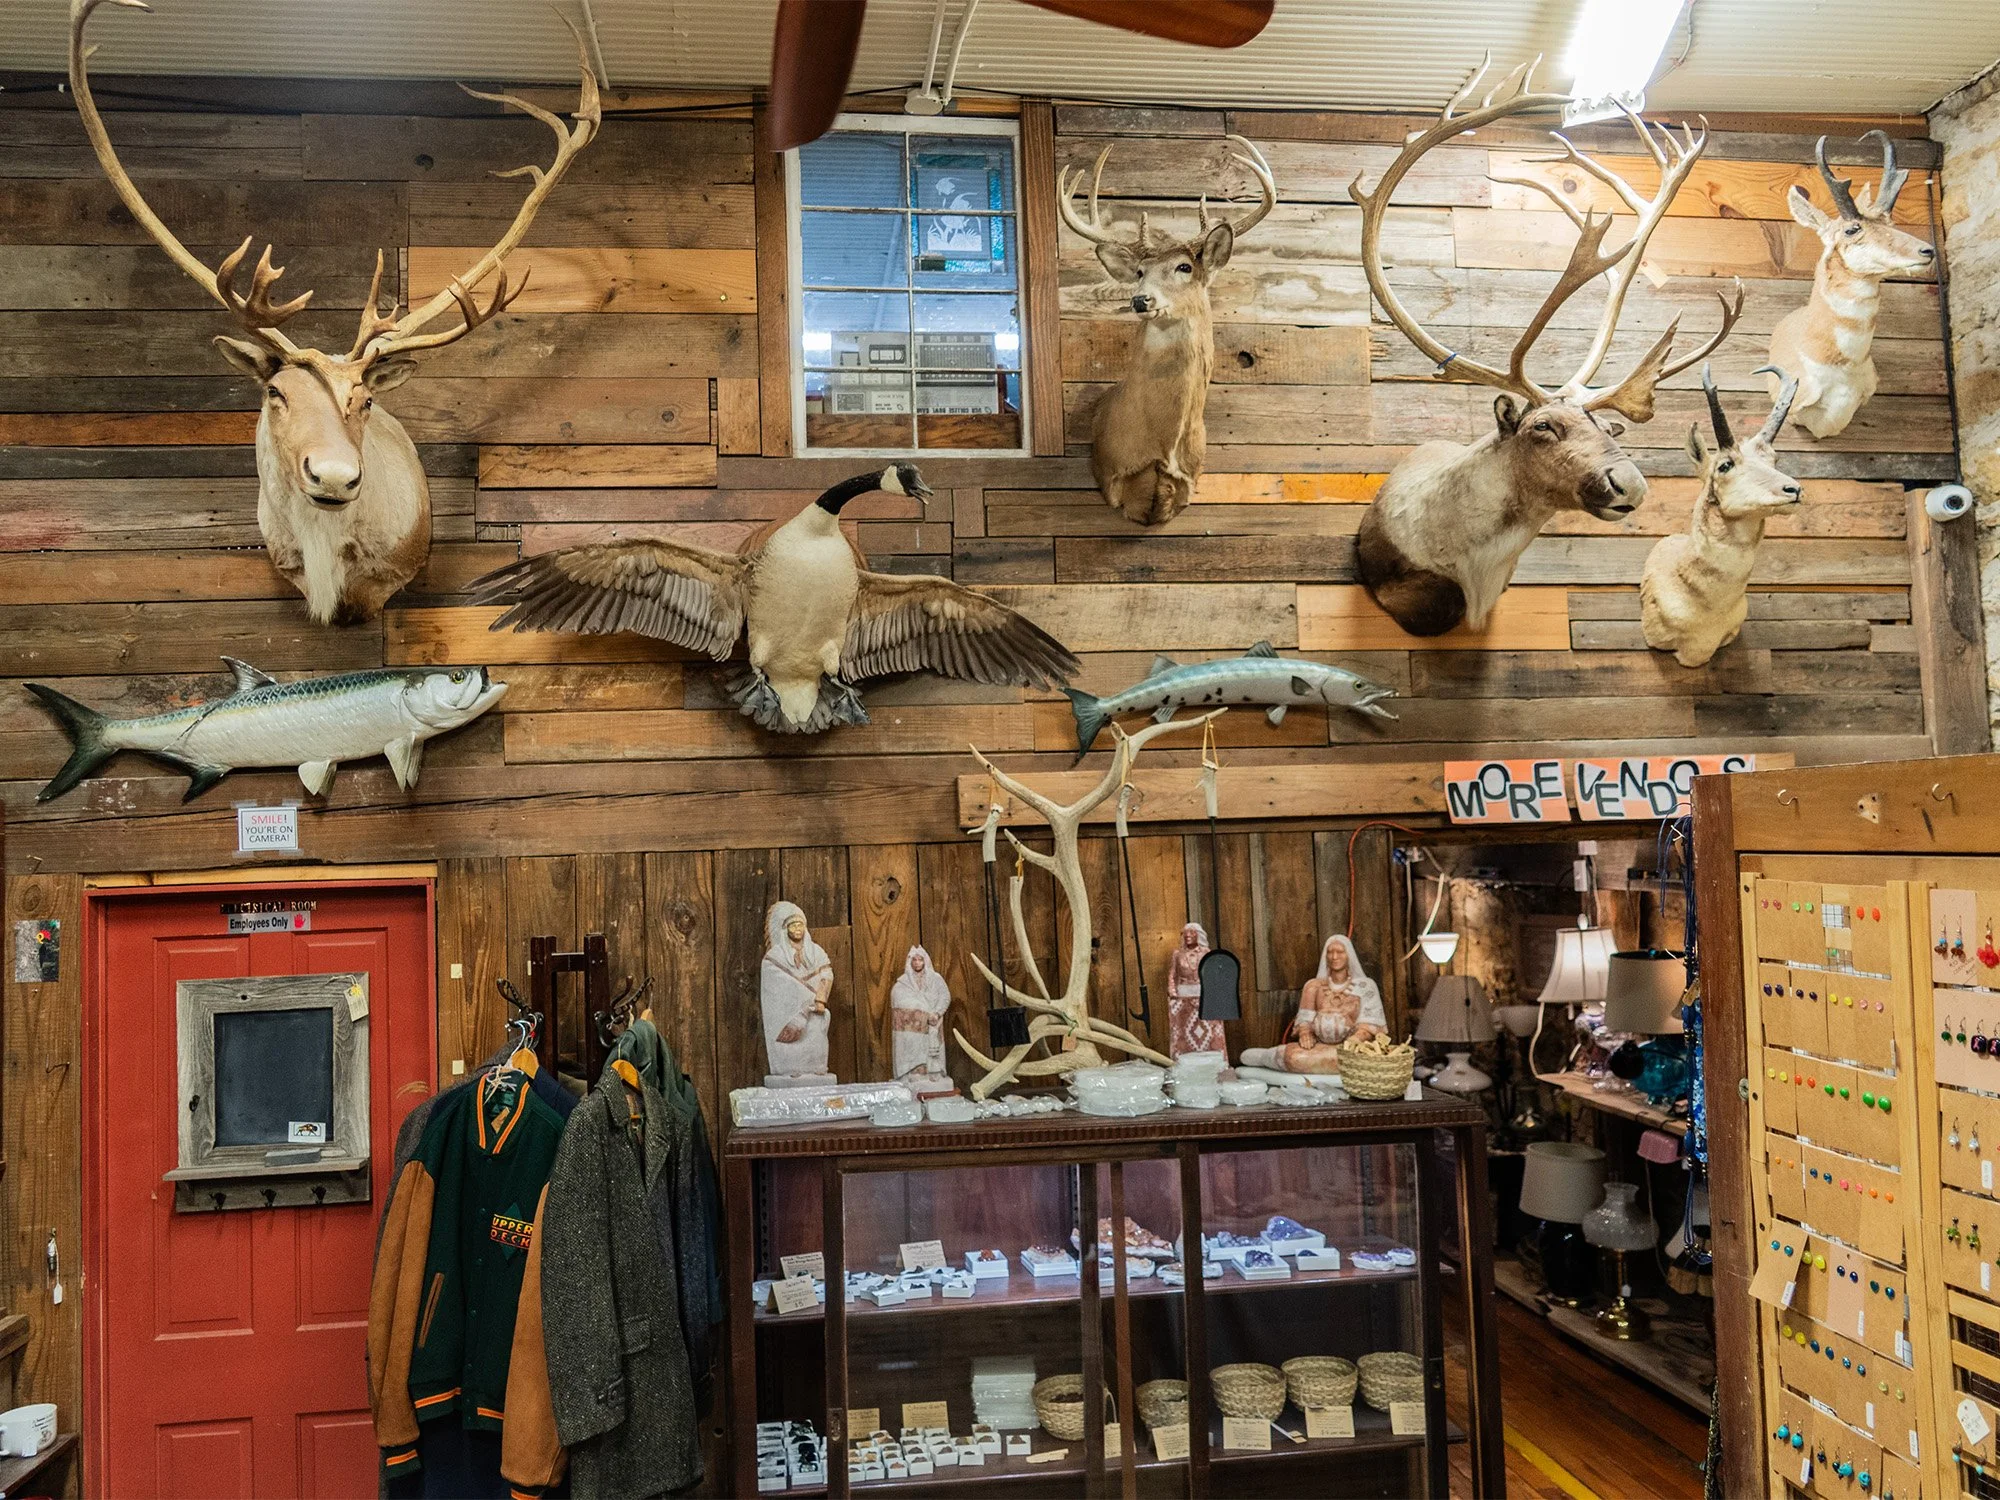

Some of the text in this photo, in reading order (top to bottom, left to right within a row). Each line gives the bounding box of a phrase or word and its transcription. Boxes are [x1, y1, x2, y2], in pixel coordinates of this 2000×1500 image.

[1447, 757, 1746, 819] MORE VENDO
[251, 814, 288, 825] SMILE!
[245, 825, 294, 835] YOU'RE ON
[249, 834, 290, 843] CAMERA!
[221, 900, 317, 914] CTICAL ROOM
[229, 916, 289, 931] Employees Only
[492, 1217, 534, 1235] UPPER
